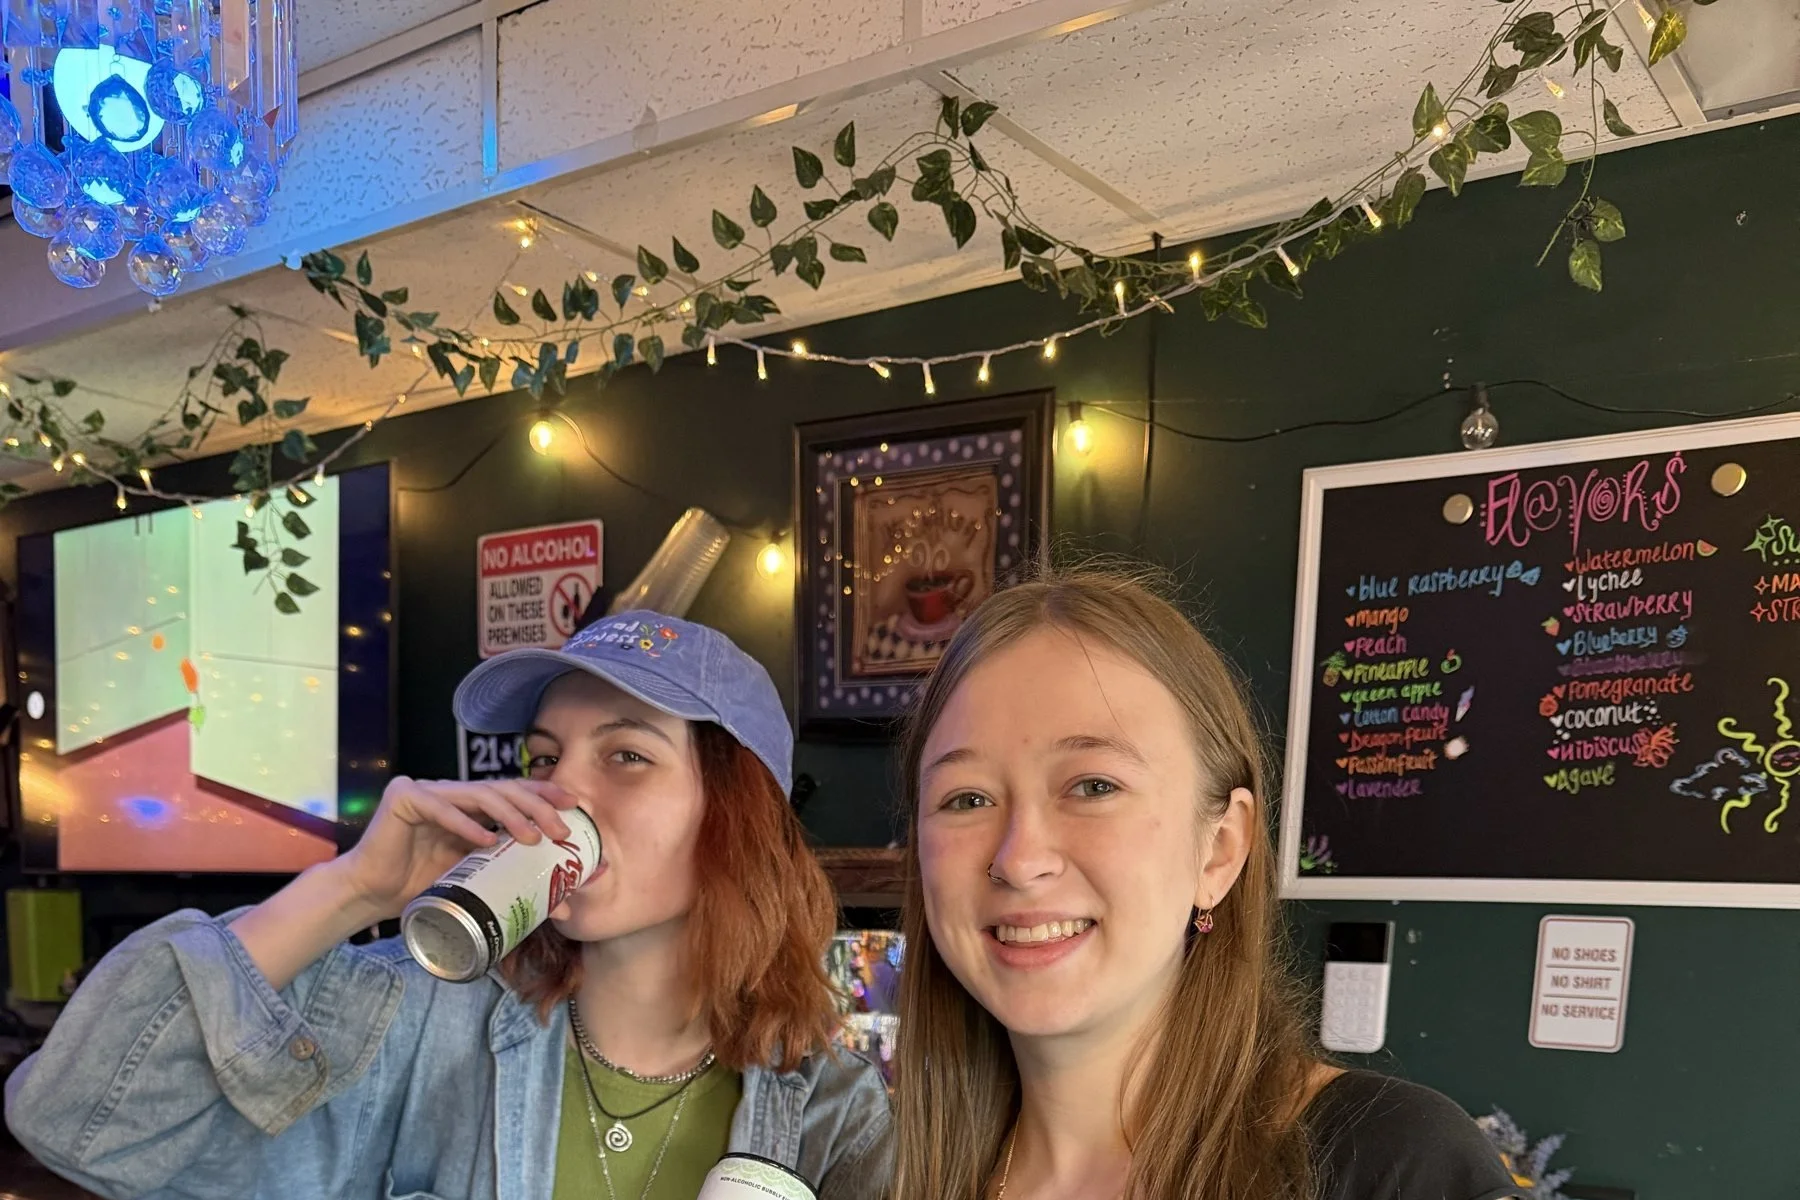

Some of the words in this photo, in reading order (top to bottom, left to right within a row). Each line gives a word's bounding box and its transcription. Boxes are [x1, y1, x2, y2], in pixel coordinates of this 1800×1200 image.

[483, 546, 509, 570] NO
[510, 536, 596, 567] ALCOHOL
[490, 576, 543, 599] ALLOWED
[487, 605, 505, 623] ON
[507, 600, 546, 621] THESE
[487, 624, 547, 646] PREMISES
[1551, 947, 1570, 961] NO
[1573, 948, 1617, 962] SHOES
[1551, 975, 1569, 989] NO
[1572, 976, 1612, 990] SHIRT
[1541, 1004, 1558, 1018] NO
[1562, 1004, 1616, 1020] SERVICE
[761, 1186, 782, 1199] BUBBLY
